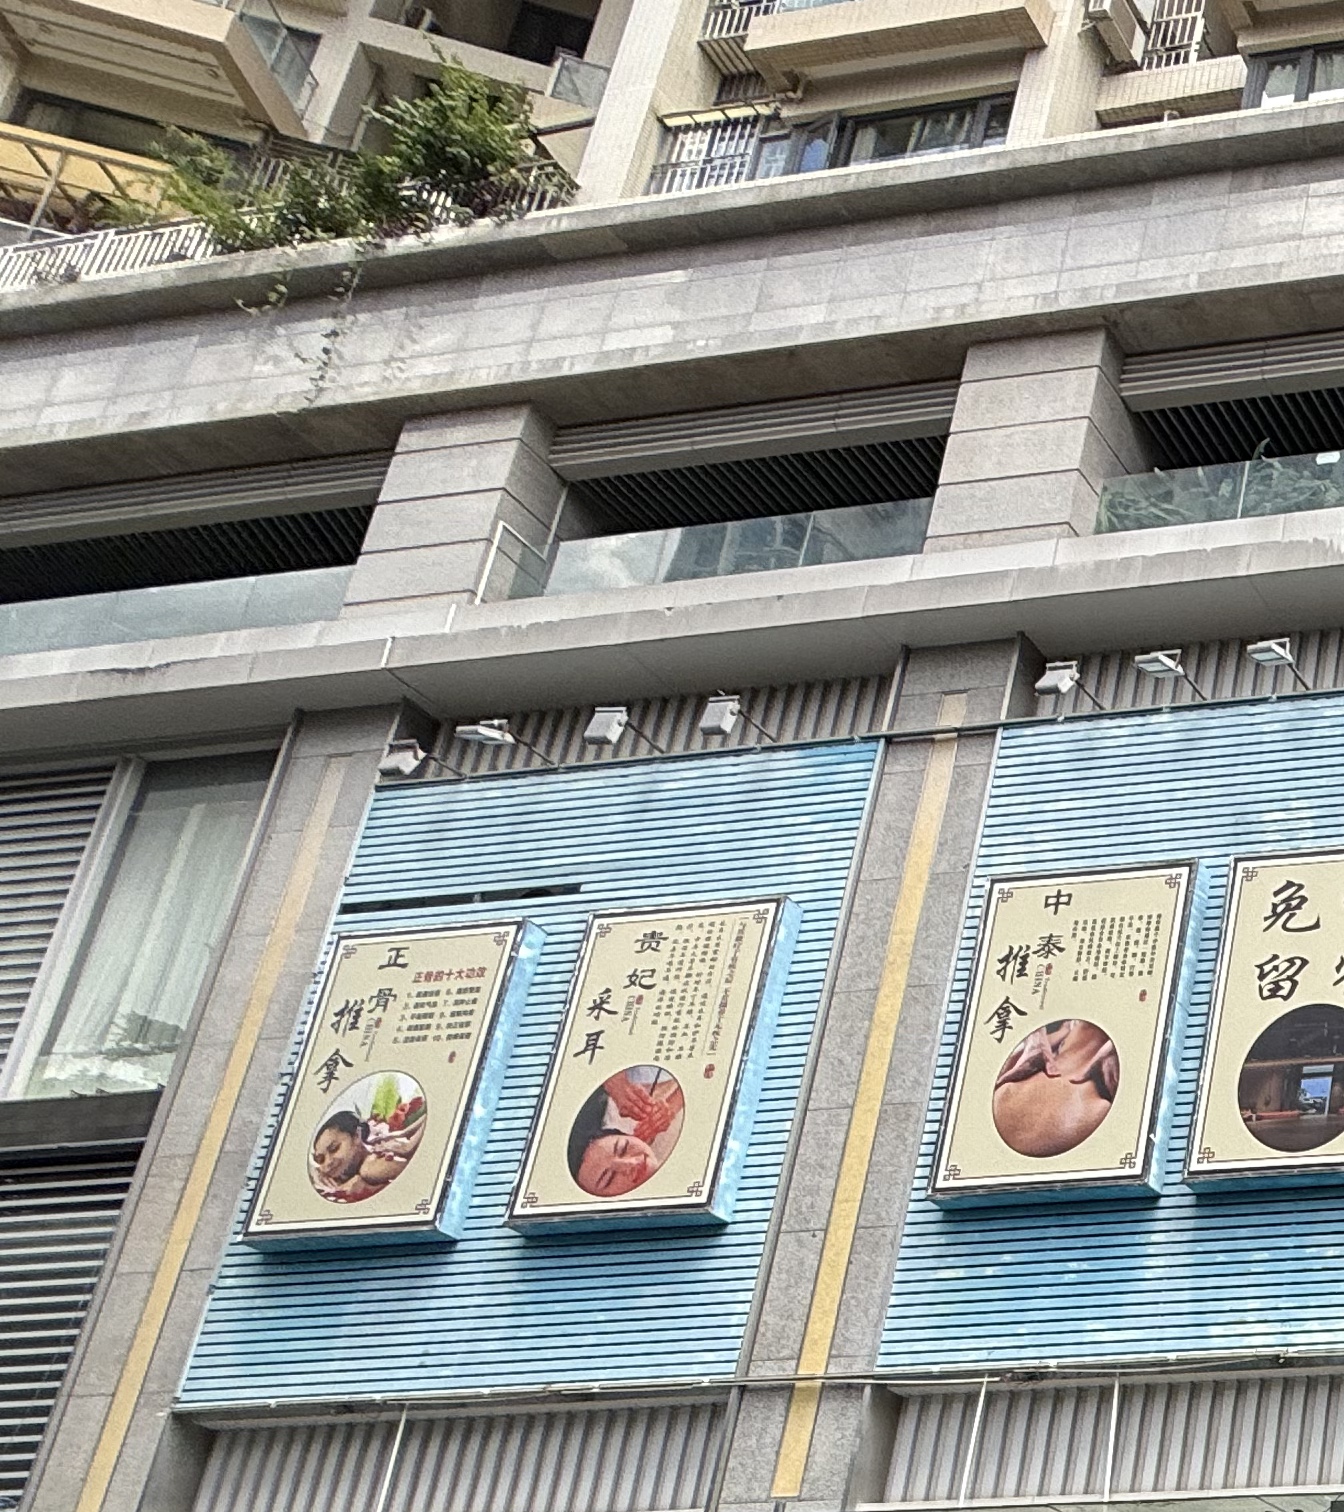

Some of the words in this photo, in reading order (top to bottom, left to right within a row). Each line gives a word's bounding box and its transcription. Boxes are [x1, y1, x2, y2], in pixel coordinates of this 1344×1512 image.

[622, 929, 668, 992] 贵妃
[1032, 888, 1073, 960] 中泰
[366, 945, 410, 1014] 正骨
[983, 943, 1030, 1043] 推拿
[314, 998, 362, 1094] 推拿
[573, 987, 618, 1064] 采耳
